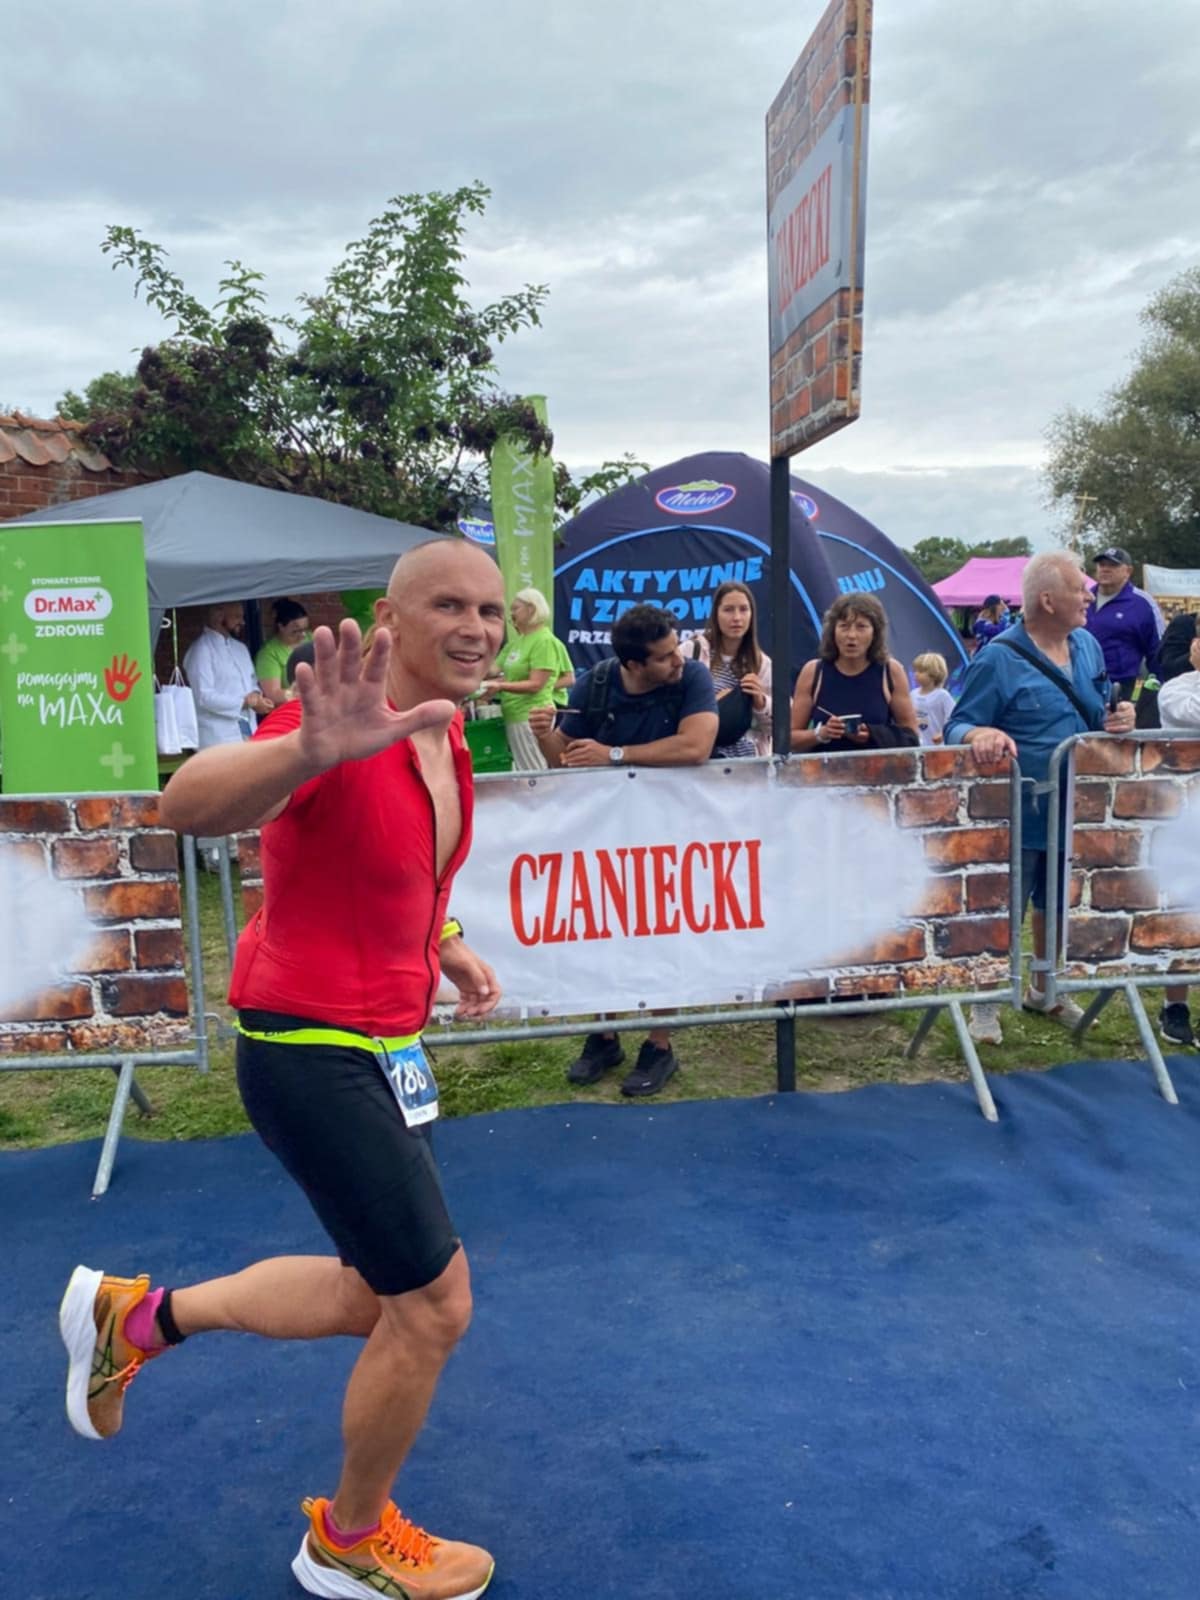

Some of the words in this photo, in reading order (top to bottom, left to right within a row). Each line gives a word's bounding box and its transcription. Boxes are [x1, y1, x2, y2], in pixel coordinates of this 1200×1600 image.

[31, 576, 102, 586] STOWARZYSZENIE
[573, 556, 764, 593] AKTYWNIE
[34, 596, 97, 614] Dr.Max
[570, 597, 583, 621] I
[34, 623, 105, 638] ZDROWIE
[16, 668, 98, 692] pomagajmy
[16, 692, 35, 707] na
[509, 839, 765, 946] CZANIECKI
